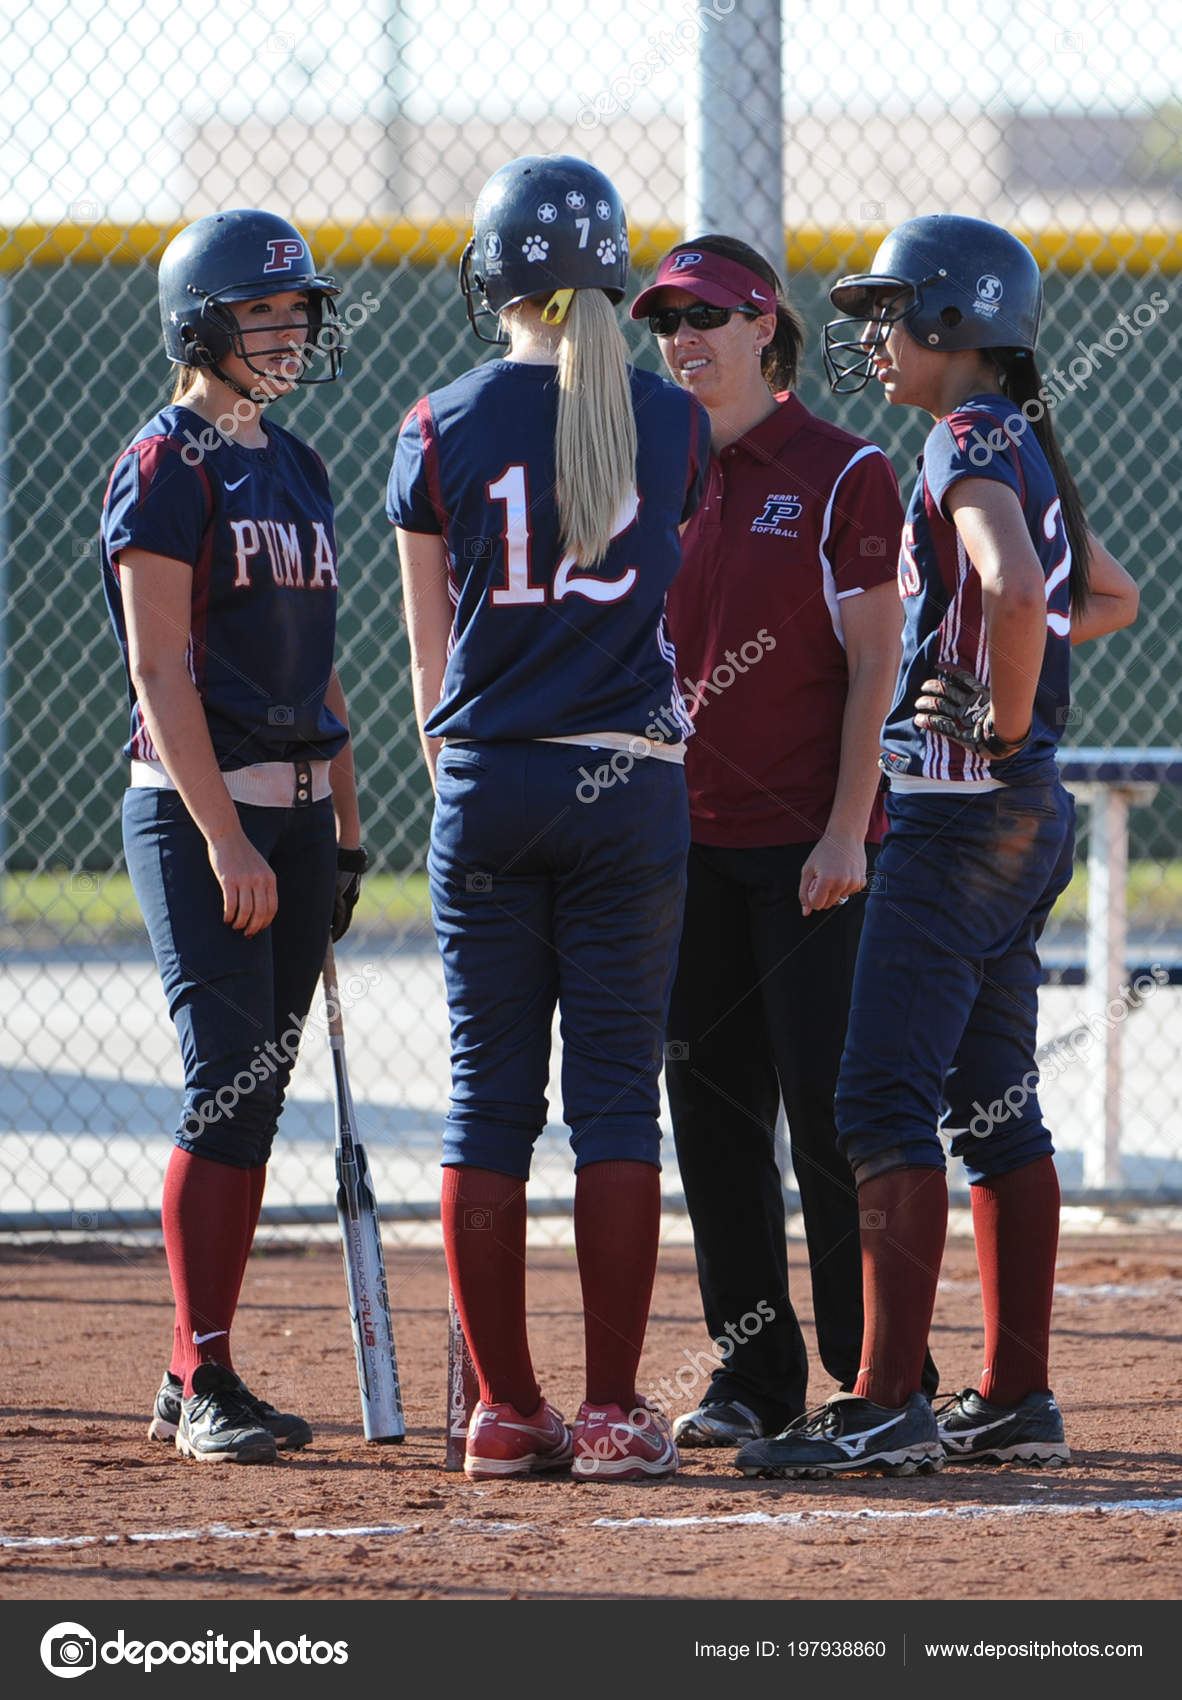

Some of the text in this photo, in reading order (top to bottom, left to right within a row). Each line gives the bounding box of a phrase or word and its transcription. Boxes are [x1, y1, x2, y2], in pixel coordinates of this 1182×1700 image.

[575, 217, 590, 249] 7
[264, 239, 304, 273] P
[669, 253, 702, 272] P
[980, 277, 1001, 300] S
[766, 494, 799, 502] PERRY
[753, 501, 802, 527] P
[485, 463, 645, 607] 12
[750, 525, 798, 538] SOFTBALL
[228, 518, 339, 590] PUMA
[451, 1314, 468, 1437] DERSON
